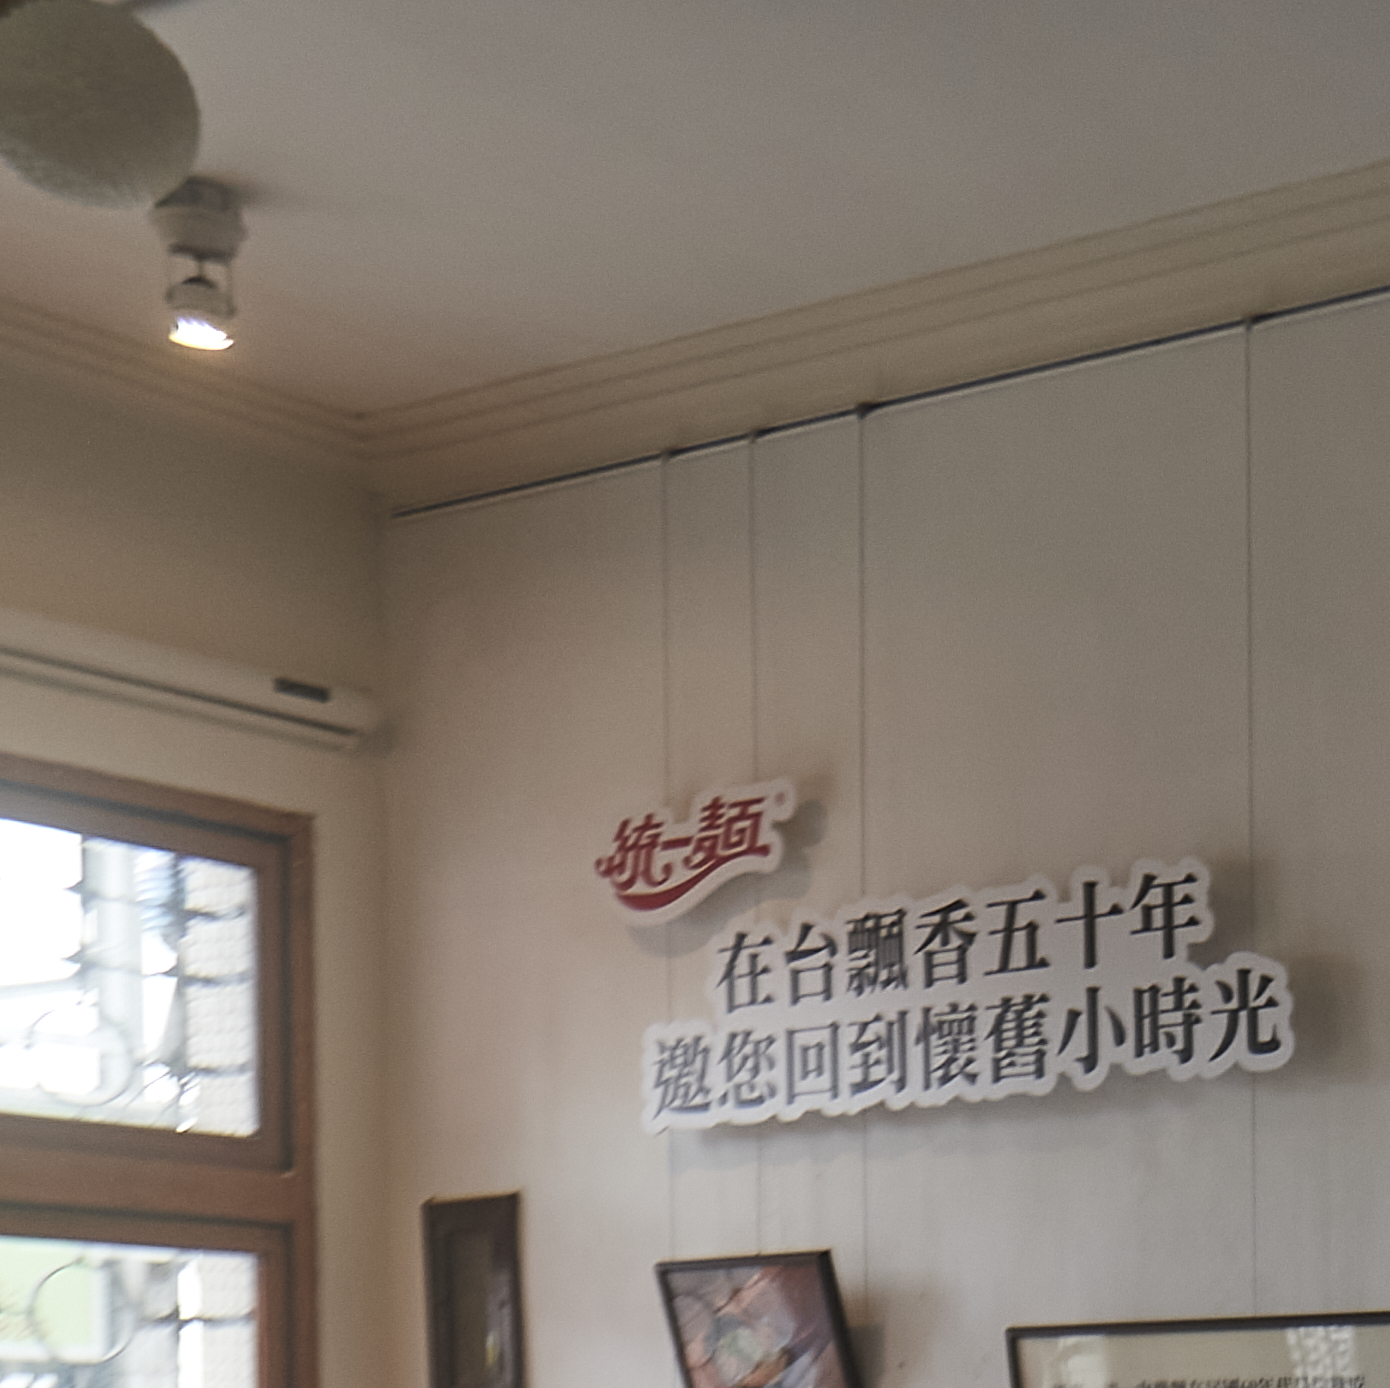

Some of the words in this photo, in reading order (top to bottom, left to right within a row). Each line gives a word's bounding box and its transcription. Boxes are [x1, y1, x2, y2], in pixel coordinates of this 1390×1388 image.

[598, 794, 772, 894] 統一麵
[716, 872, 1203, 1015] 在台飄香五十年
[650, 968, 1282, 1117] 邀您回到懷舊小時光
